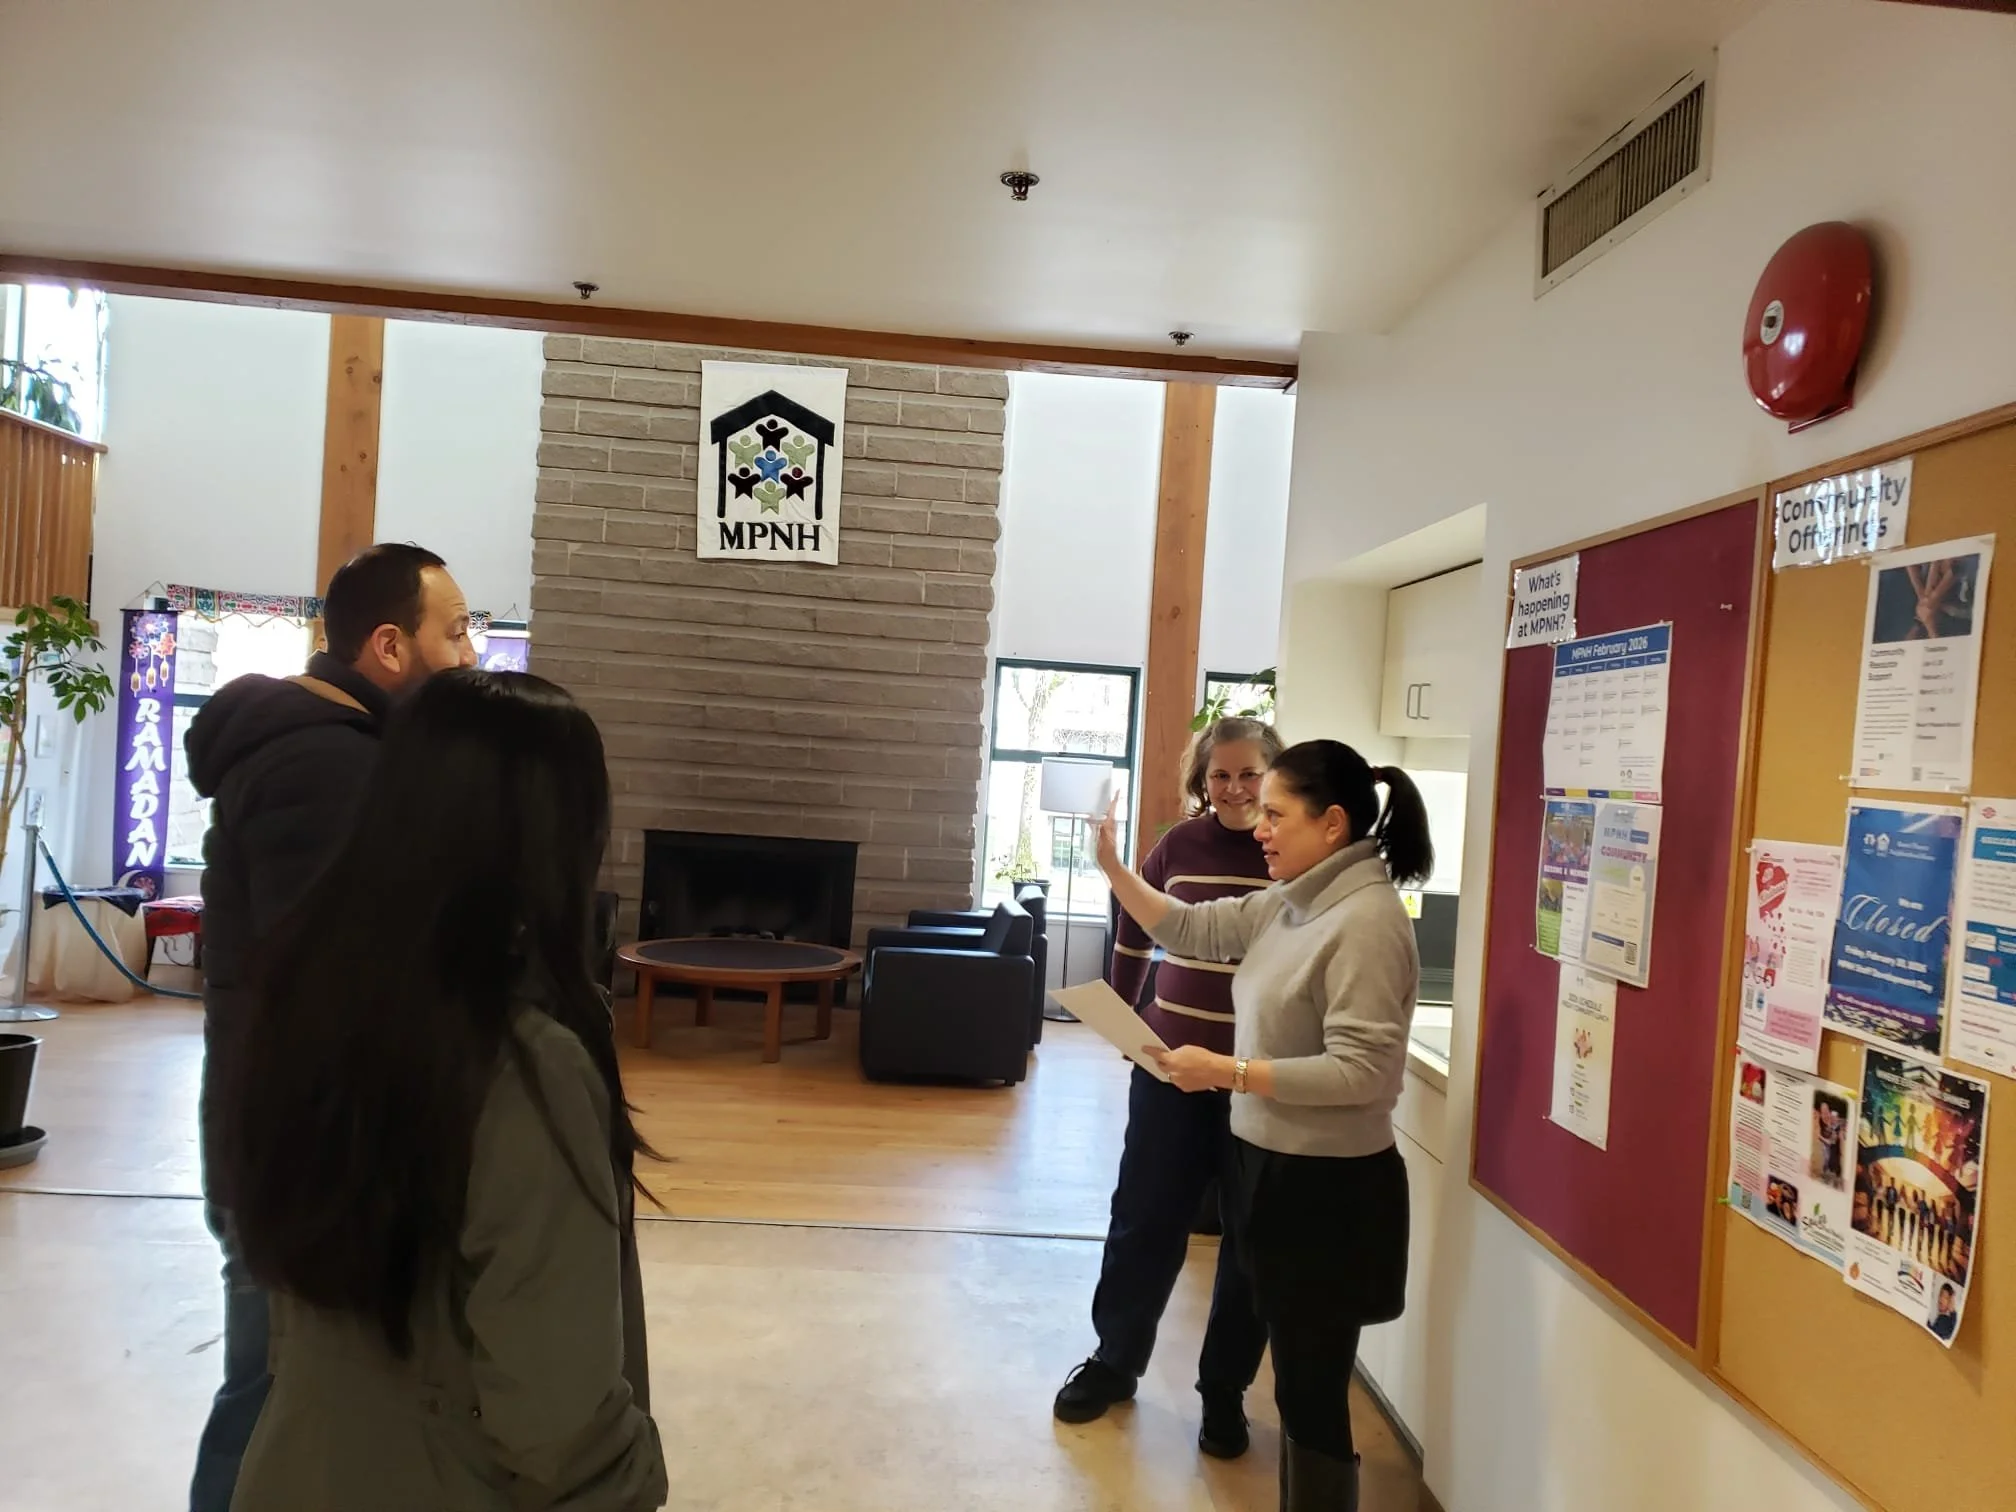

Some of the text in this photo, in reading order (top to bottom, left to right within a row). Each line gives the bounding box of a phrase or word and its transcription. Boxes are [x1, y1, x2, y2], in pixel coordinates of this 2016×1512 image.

[718, 521, 820, 552] MPNH
[1528, 570, 1561, 593] What's
[1518, 591, 1570, 619] happening
[1517, 614, 1566, 638] at MPNH?
[1592, 642, 1628, 656] February
[1628, 636, 1649, 651] 2026
[124, 698, 167, 867] RAMADAN
[1843, 893, 1948, 943] Closed
